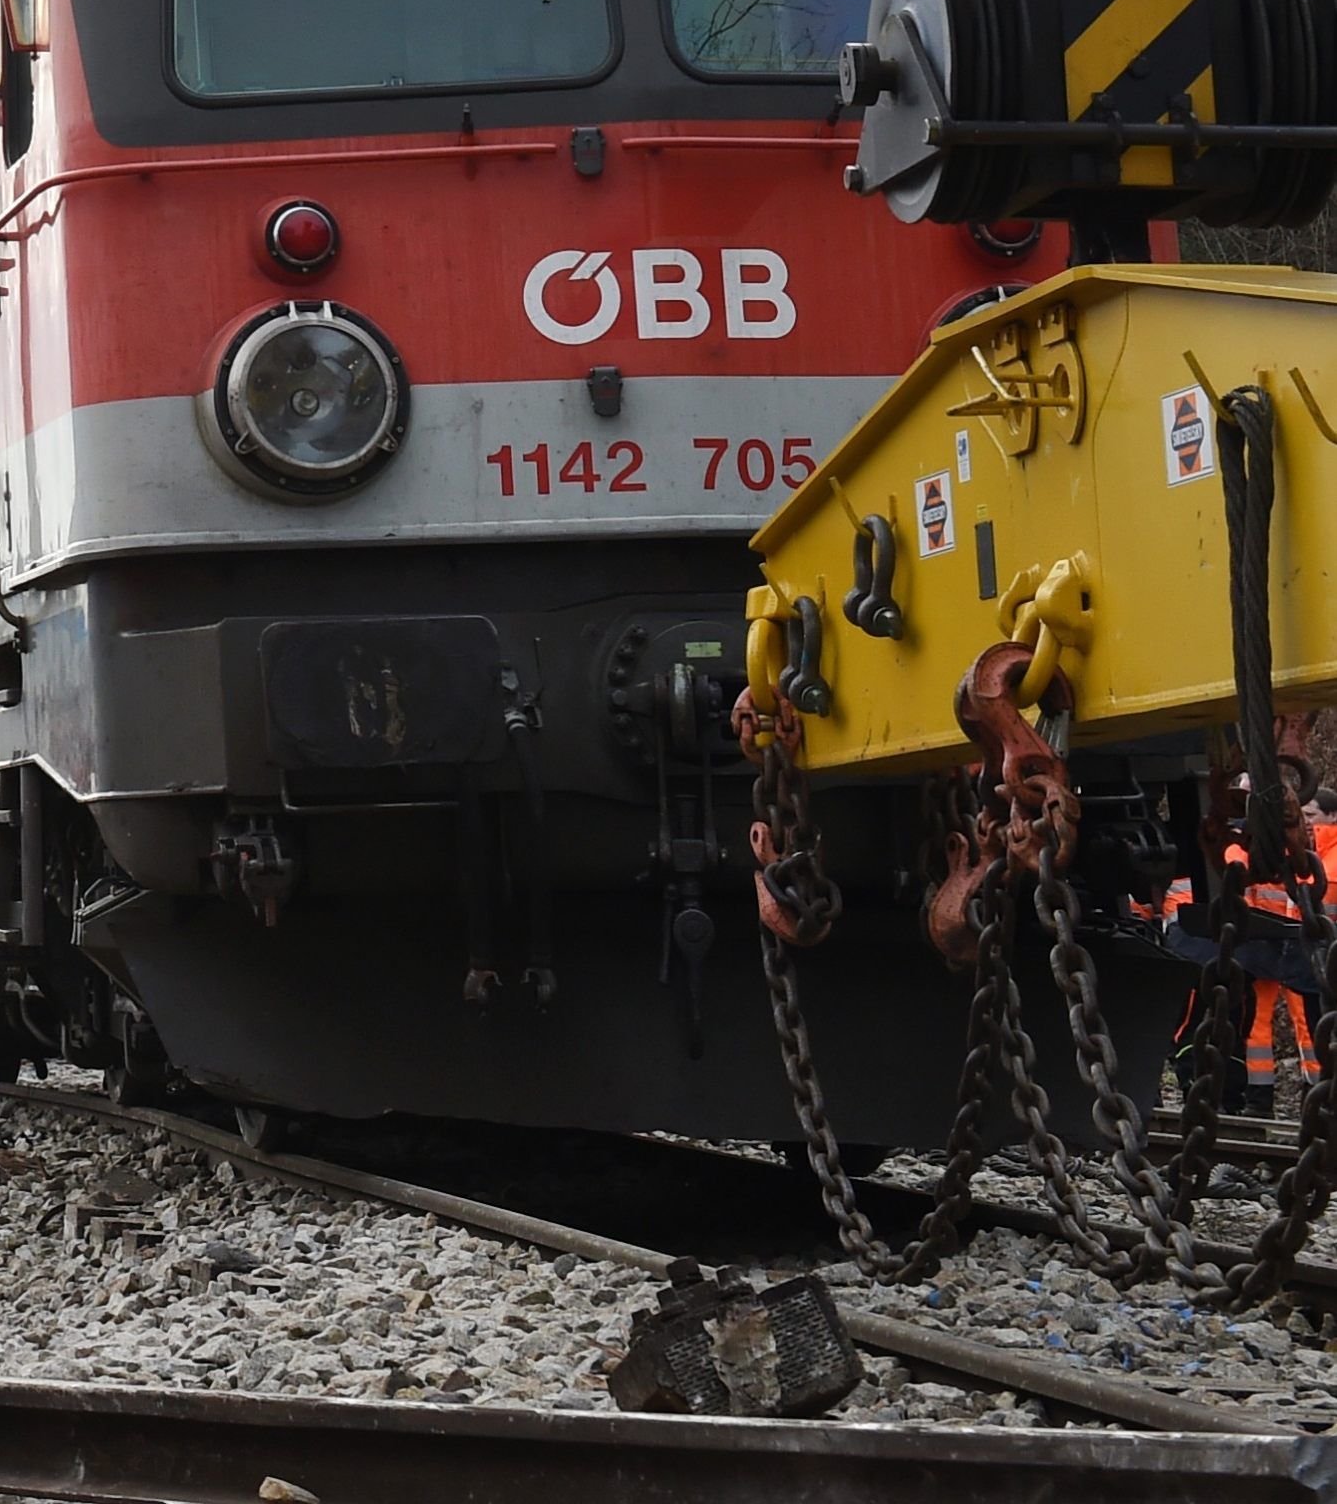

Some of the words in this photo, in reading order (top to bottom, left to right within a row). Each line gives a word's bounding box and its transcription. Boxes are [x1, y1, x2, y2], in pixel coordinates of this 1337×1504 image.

[523, 248, 797, 346] ÖBB
[486, 440, 648, 497] 1142
[693, 438, 816, 492] 705
